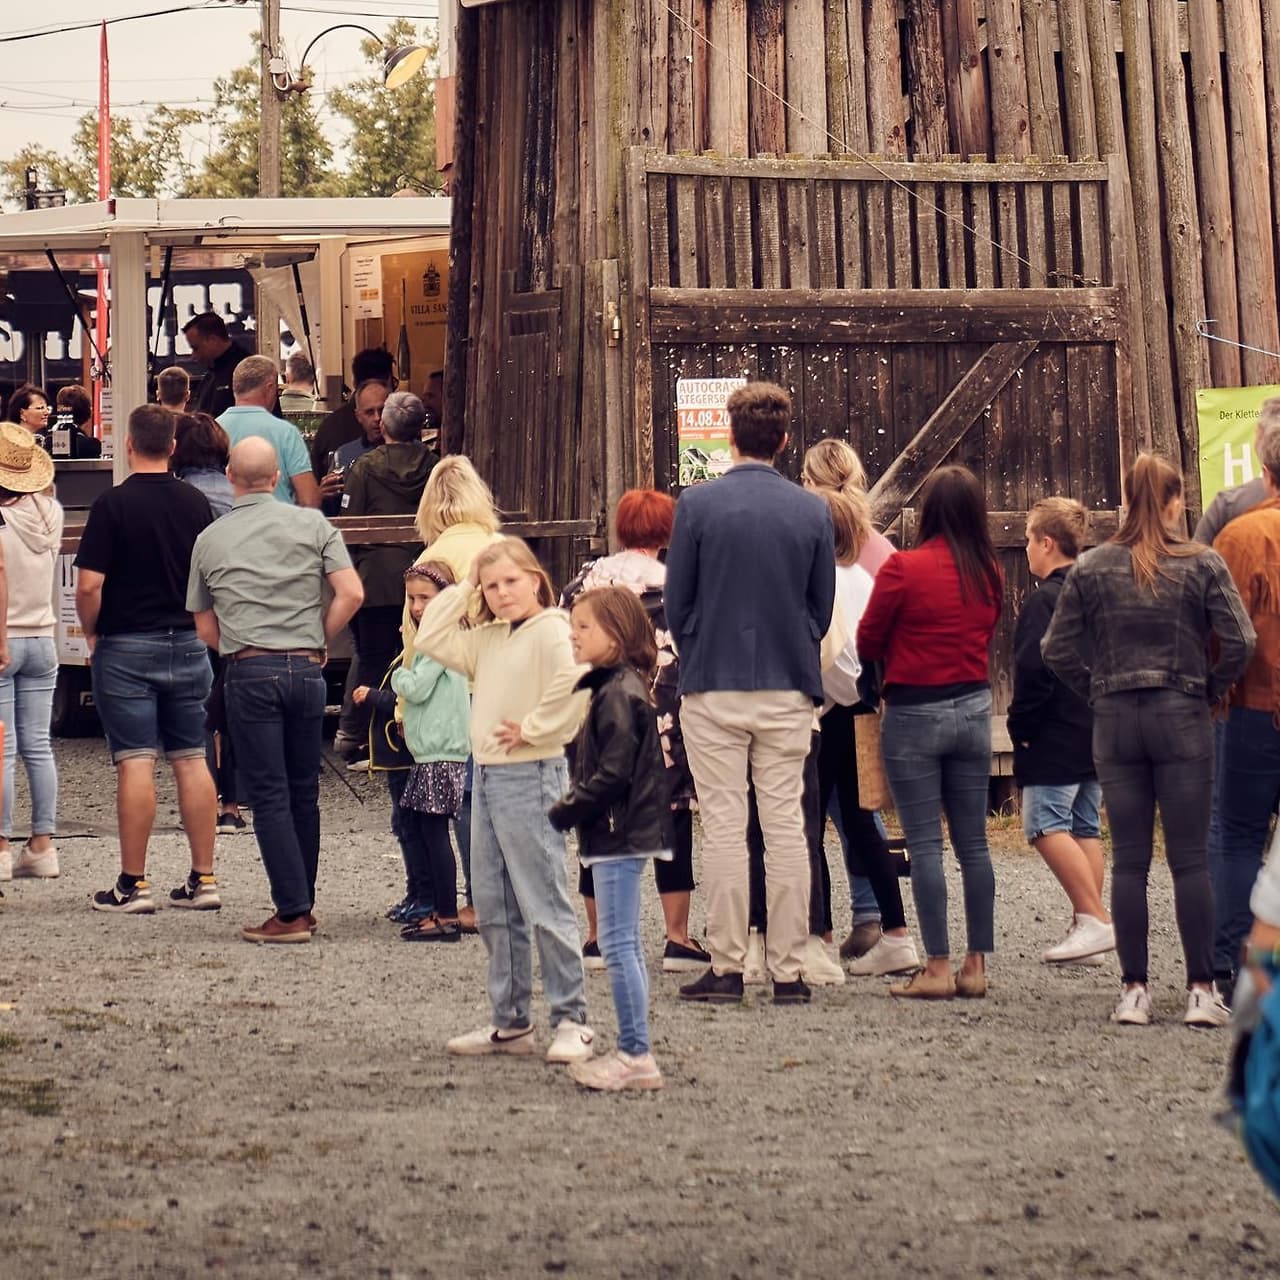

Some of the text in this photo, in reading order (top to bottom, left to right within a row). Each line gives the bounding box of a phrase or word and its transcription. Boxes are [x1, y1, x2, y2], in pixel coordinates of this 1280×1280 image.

[432, 303, 449, 313] SAN
[679, 394, 727, 405] STEGERSB
[680, 410, 730, 427] 14.08.20
[1219, 410, 1233, 420] Der
